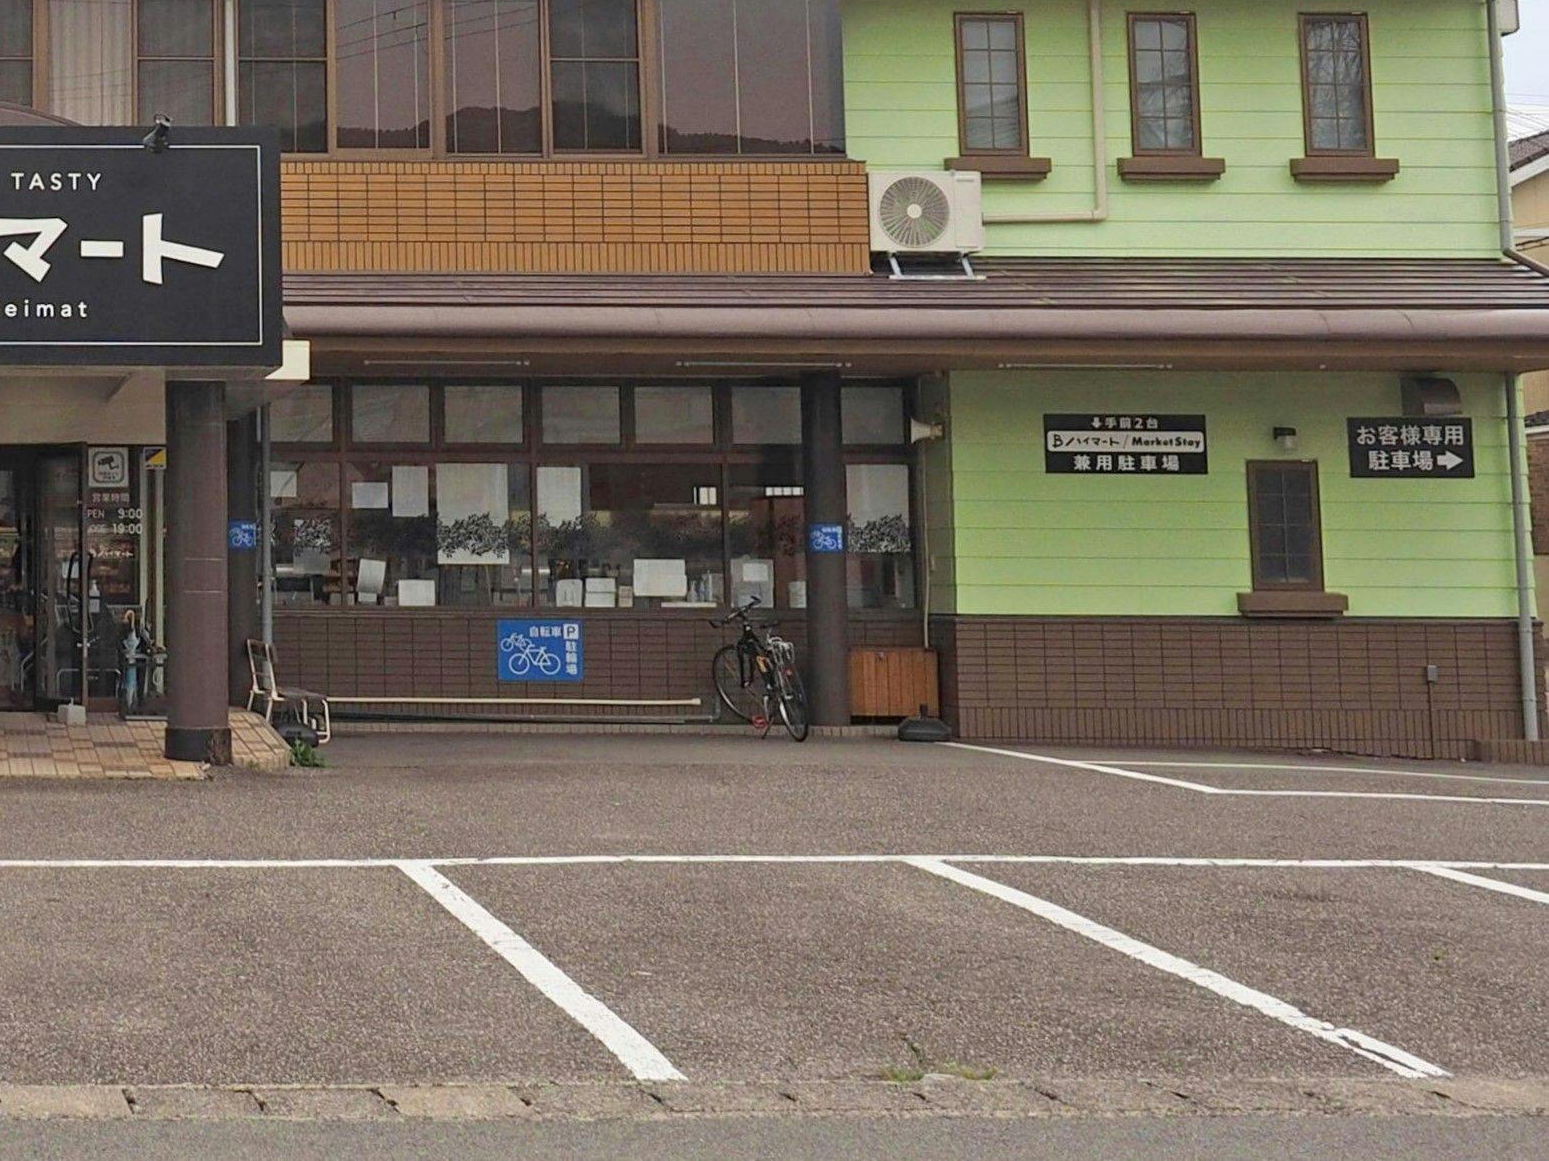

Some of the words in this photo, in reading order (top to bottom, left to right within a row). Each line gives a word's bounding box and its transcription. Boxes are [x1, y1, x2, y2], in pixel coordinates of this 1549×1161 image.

[10, 172, 102, 191] TASTY
[1105, 416, 1159, 430] 手前2台
[1356, 424, 1464, 446] お客様専用
[1073, 454, 1180, 472] 兼用駐車場
[1368, 449, 1434, 471] 駐車場
[117, 508, 144, 519] 9:00
[112, 523, 144, 535] 19:00
[529, 625, 562, 638] 自転車
[565, 640, 578, 675] 駐輪場
